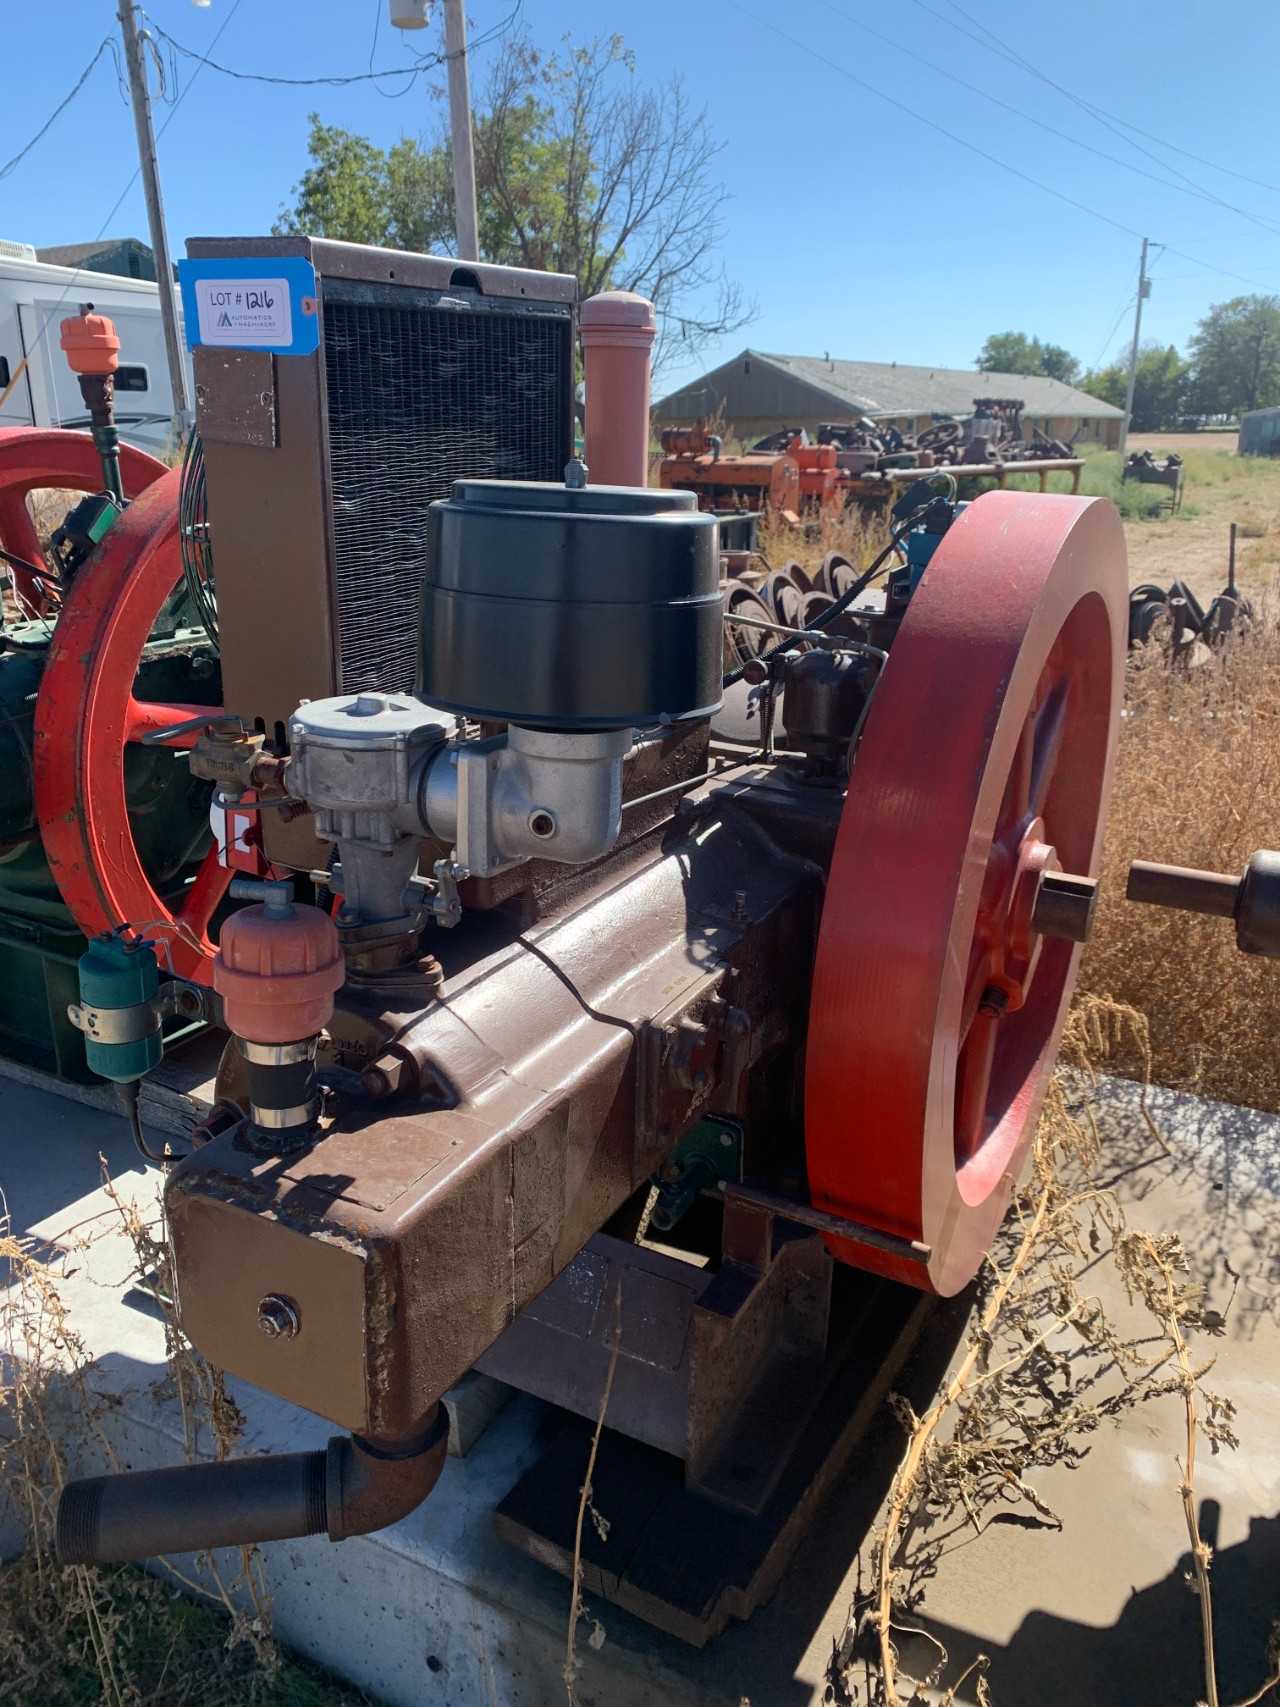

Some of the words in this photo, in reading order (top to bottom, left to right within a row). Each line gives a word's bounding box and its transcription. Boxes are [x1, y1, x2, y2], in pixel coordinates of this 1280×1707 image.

[210, 292, 232, 306] LOT
[235, 291, 242, 305] #
[246, 290, 274, 310] 1216
